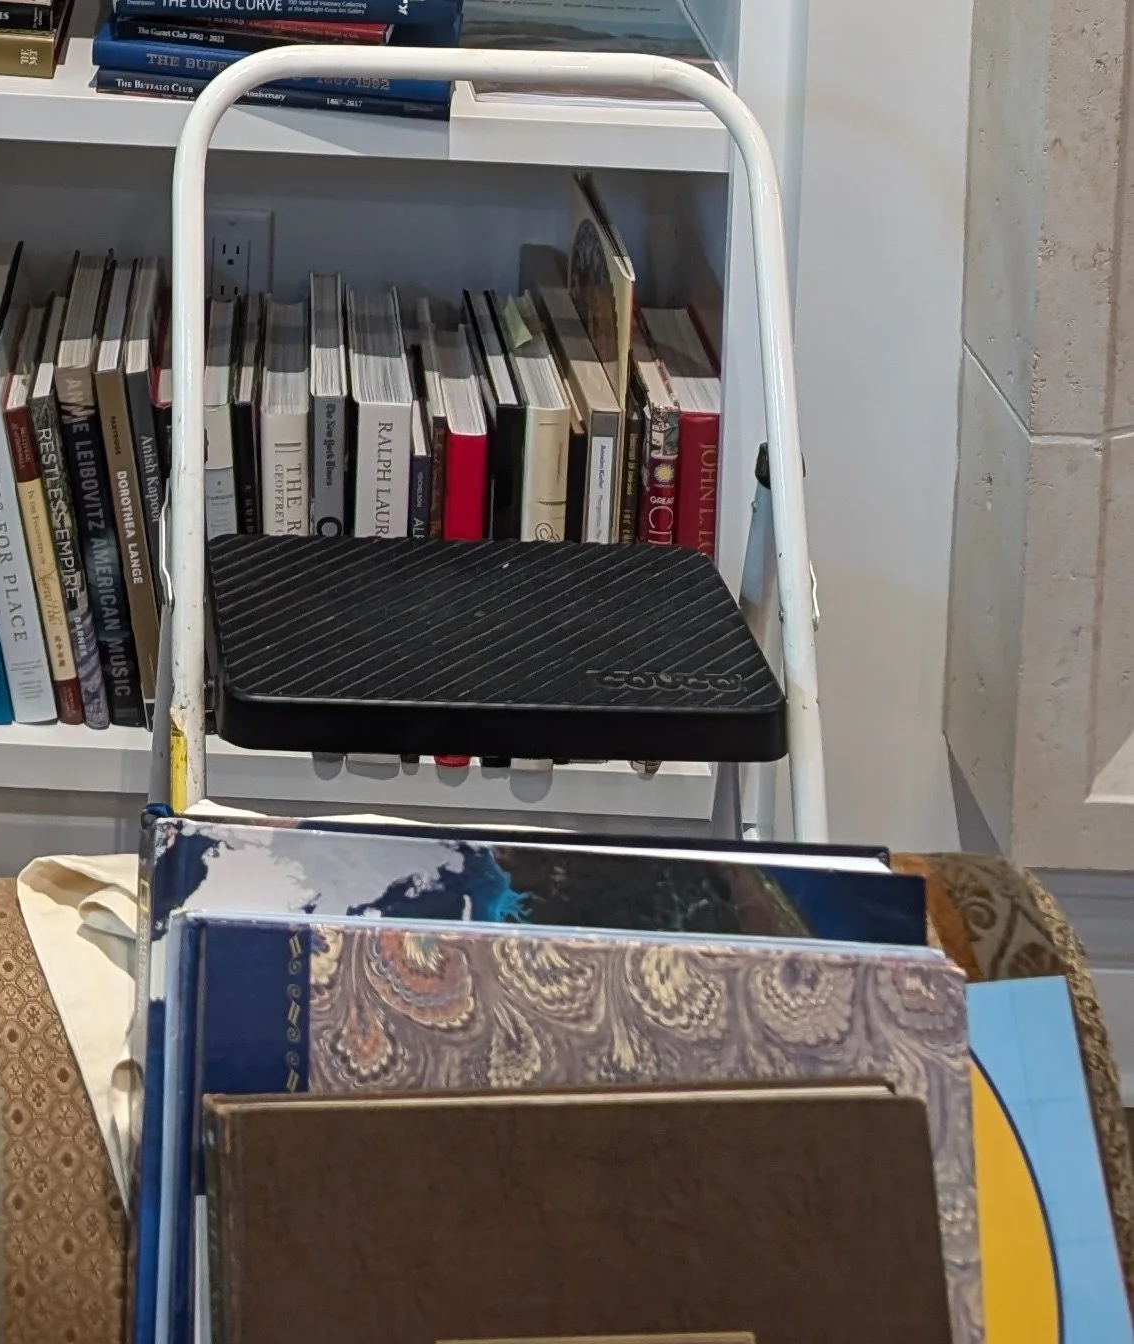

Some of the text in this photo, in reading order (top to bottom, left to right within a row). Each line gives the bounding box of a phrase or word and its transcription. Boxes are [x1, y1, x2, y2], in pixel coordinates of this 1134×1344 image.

[376, 421, 393, 482] RALPH
[114, 470, 144, 584] DOROTHEA LANGE
